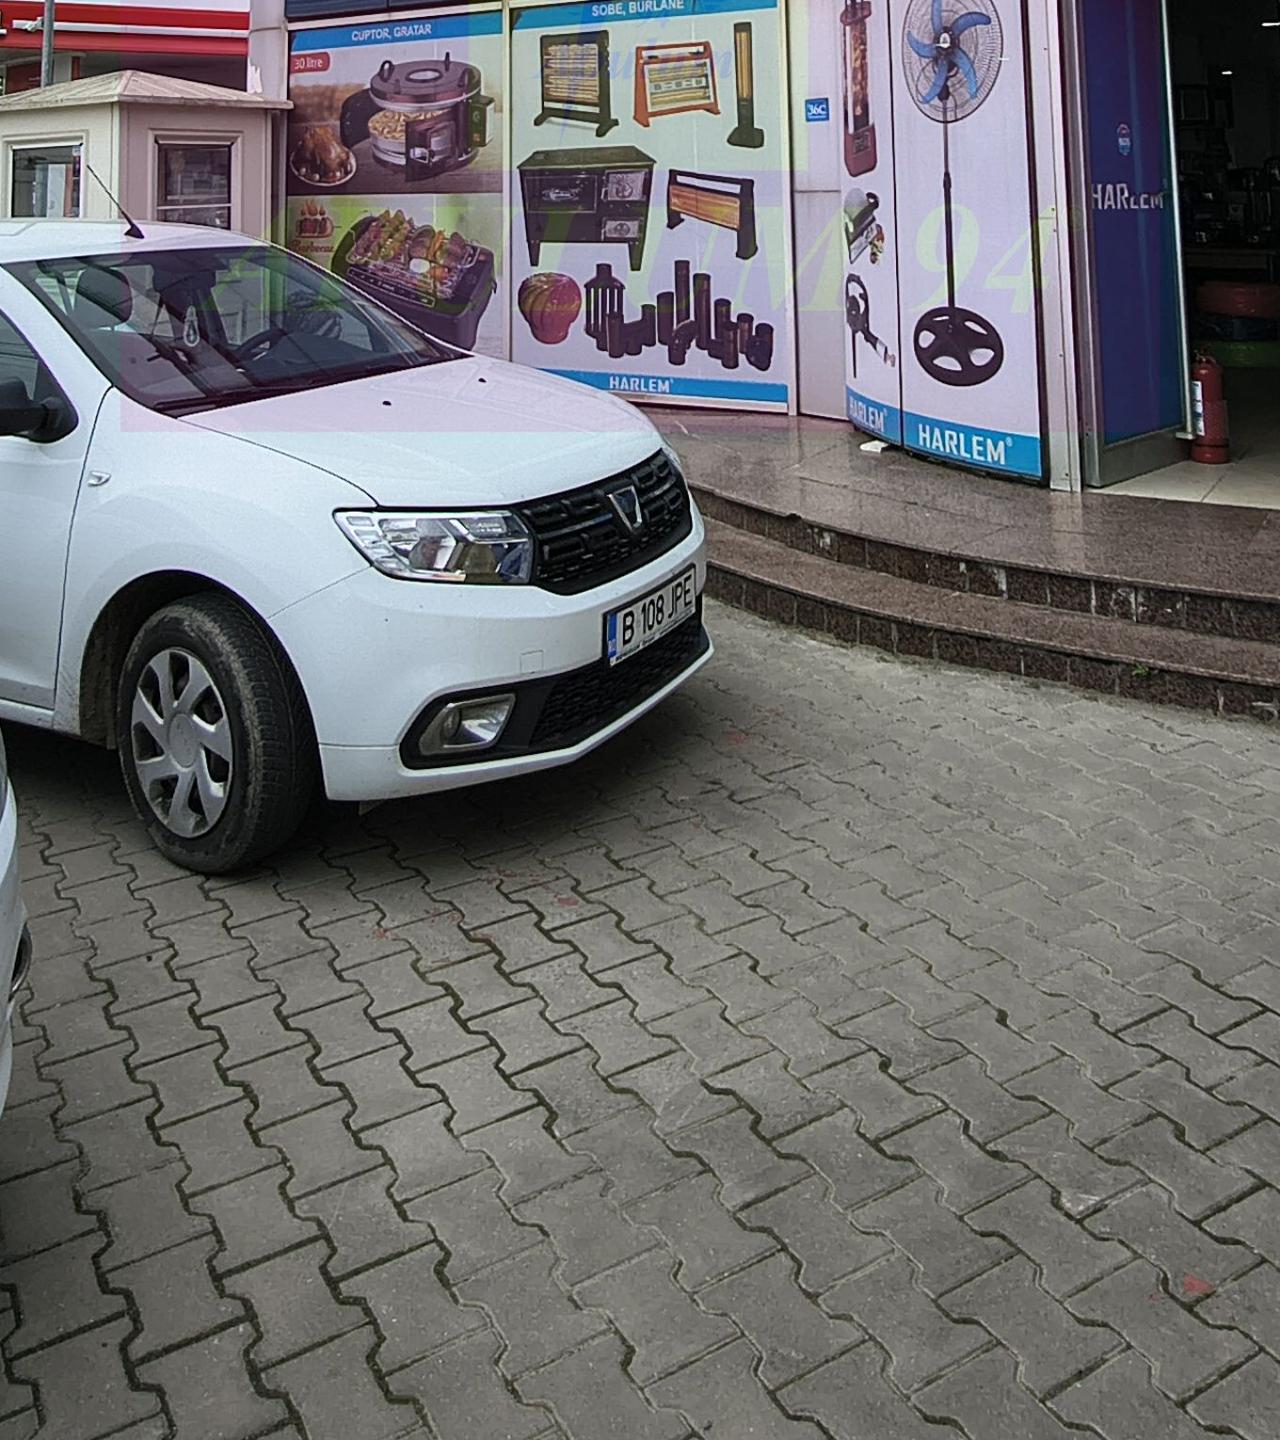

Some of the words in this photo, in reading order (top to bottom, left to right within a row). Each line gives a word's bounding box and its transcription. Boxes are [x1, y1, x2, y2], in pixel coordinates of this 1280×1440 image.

[592, 2, 626, 17] SOBE,
[393, 23, 433, 38] GRATAR
[609, 375, 671, 393] HARLEM
[849, 395, 885, 432] HARLEM
[918, 423, 1006, 465] HARLEM
[622, 610, 635, 646] B
[641, 594, 664, 634] 108
[668, 574, 692, 619] JPE
